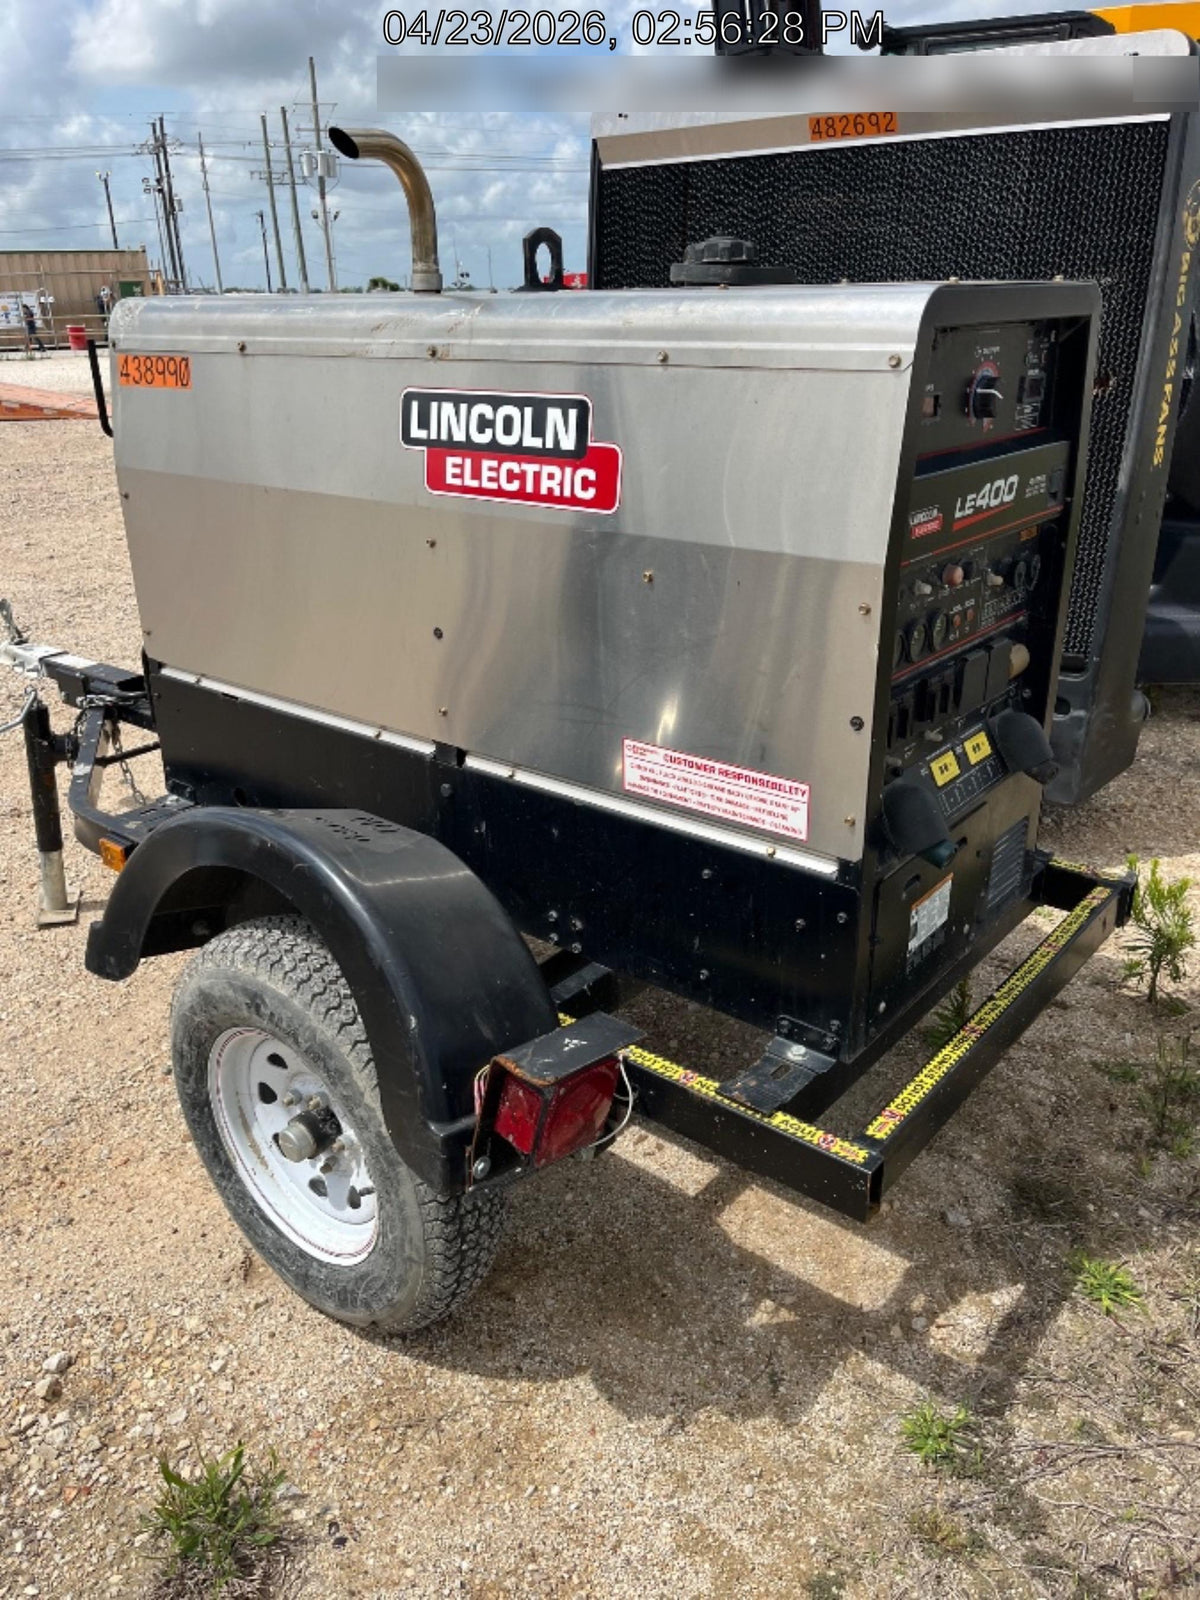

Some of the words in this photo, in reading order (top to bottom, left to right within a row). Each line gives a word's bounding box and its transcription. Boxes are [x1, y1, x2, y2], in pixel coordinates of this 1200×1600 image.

[811, 111, 896, 139] 482692
[1176, 251, 1191, 307] BIG
[1165, 311, 1182, 379] ASS
[120, 355, 189, 387] 438990
[409, 399, 579, 451] LINCOLN
[1152, 382, 1173, 466] FANS
[444, 455, 598, 501] ELECTRIC
[954, 473, 1020, 520] LE400
[663, 752, 717, 775] CUSTOMER
[717, 766, 808, 798] RESPONSIBILITY
